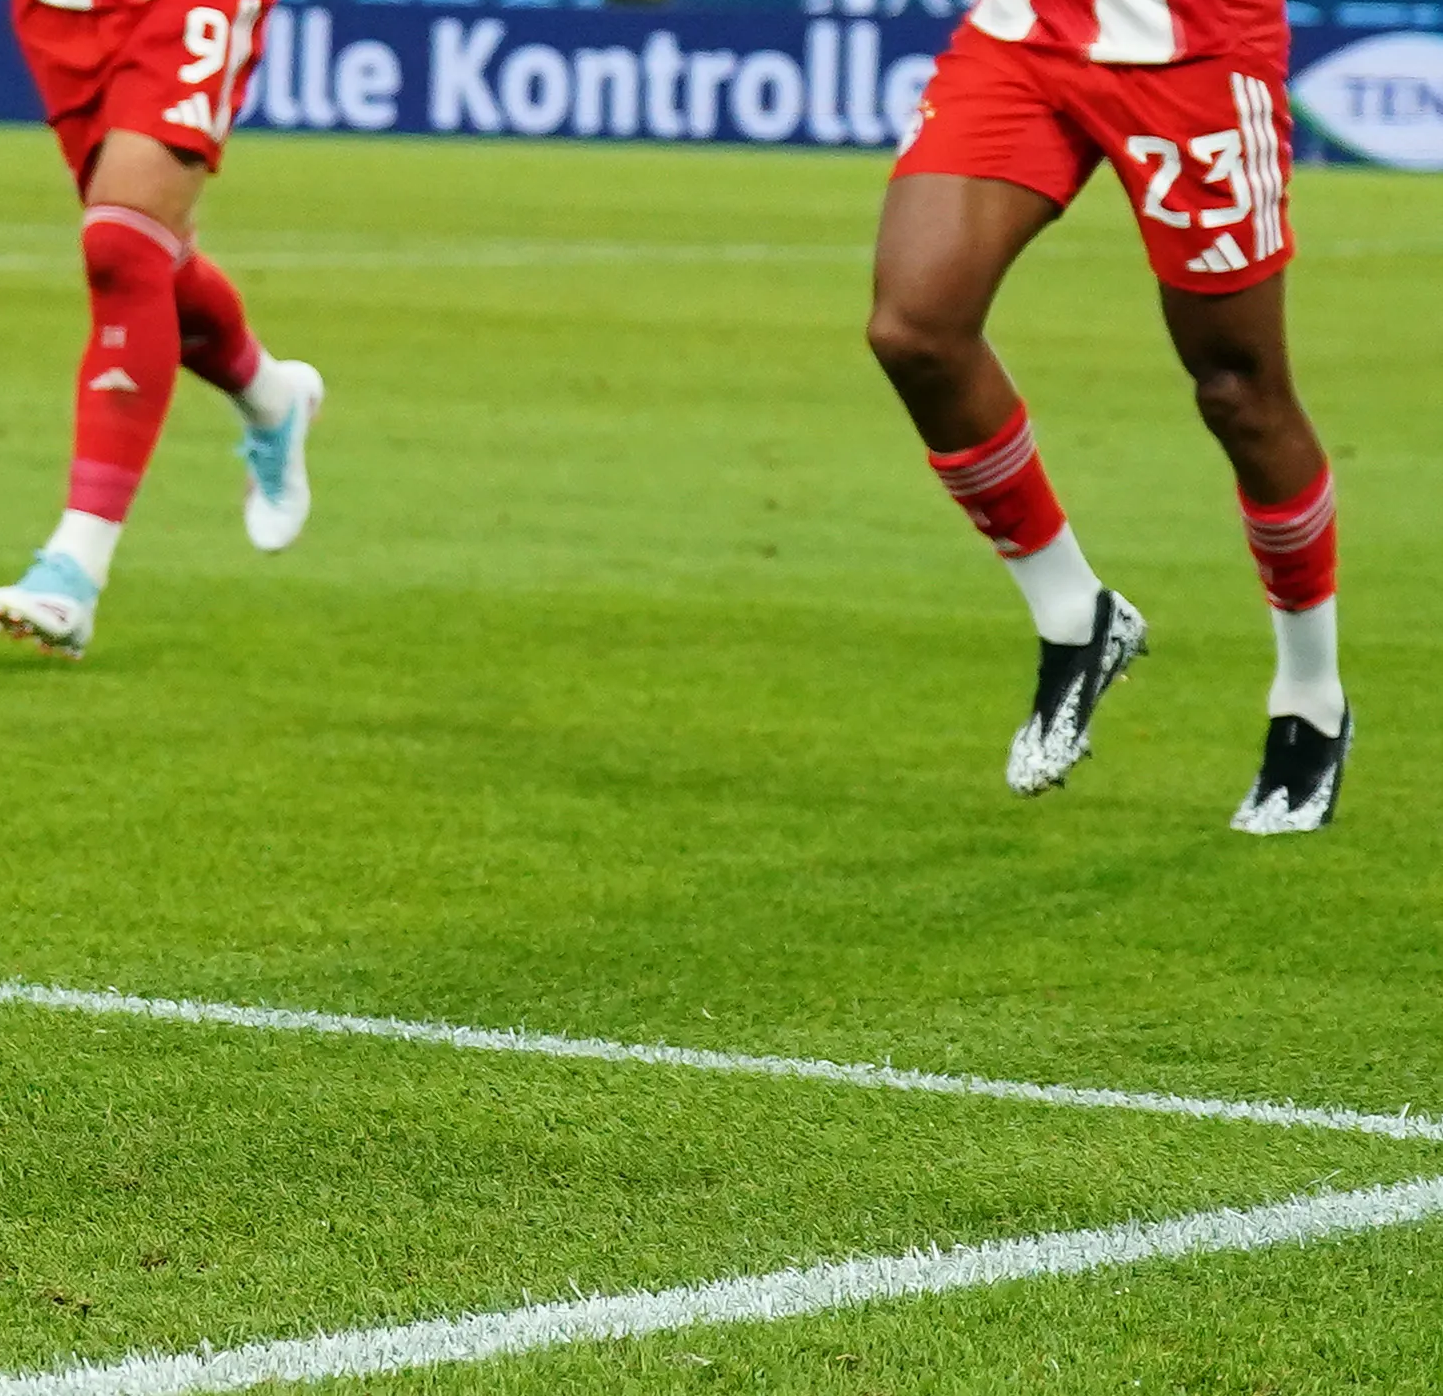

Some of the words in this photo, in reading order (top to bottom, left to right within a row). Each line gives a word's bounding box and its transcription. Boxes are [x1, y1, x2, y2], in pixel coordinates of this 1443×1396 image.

[177, 5, 231, 85] 9
[234, 6, 402, 130] lle
[426, 15, 940, 147] Kontrolle
[1126, 128, 1253, 230] 23
